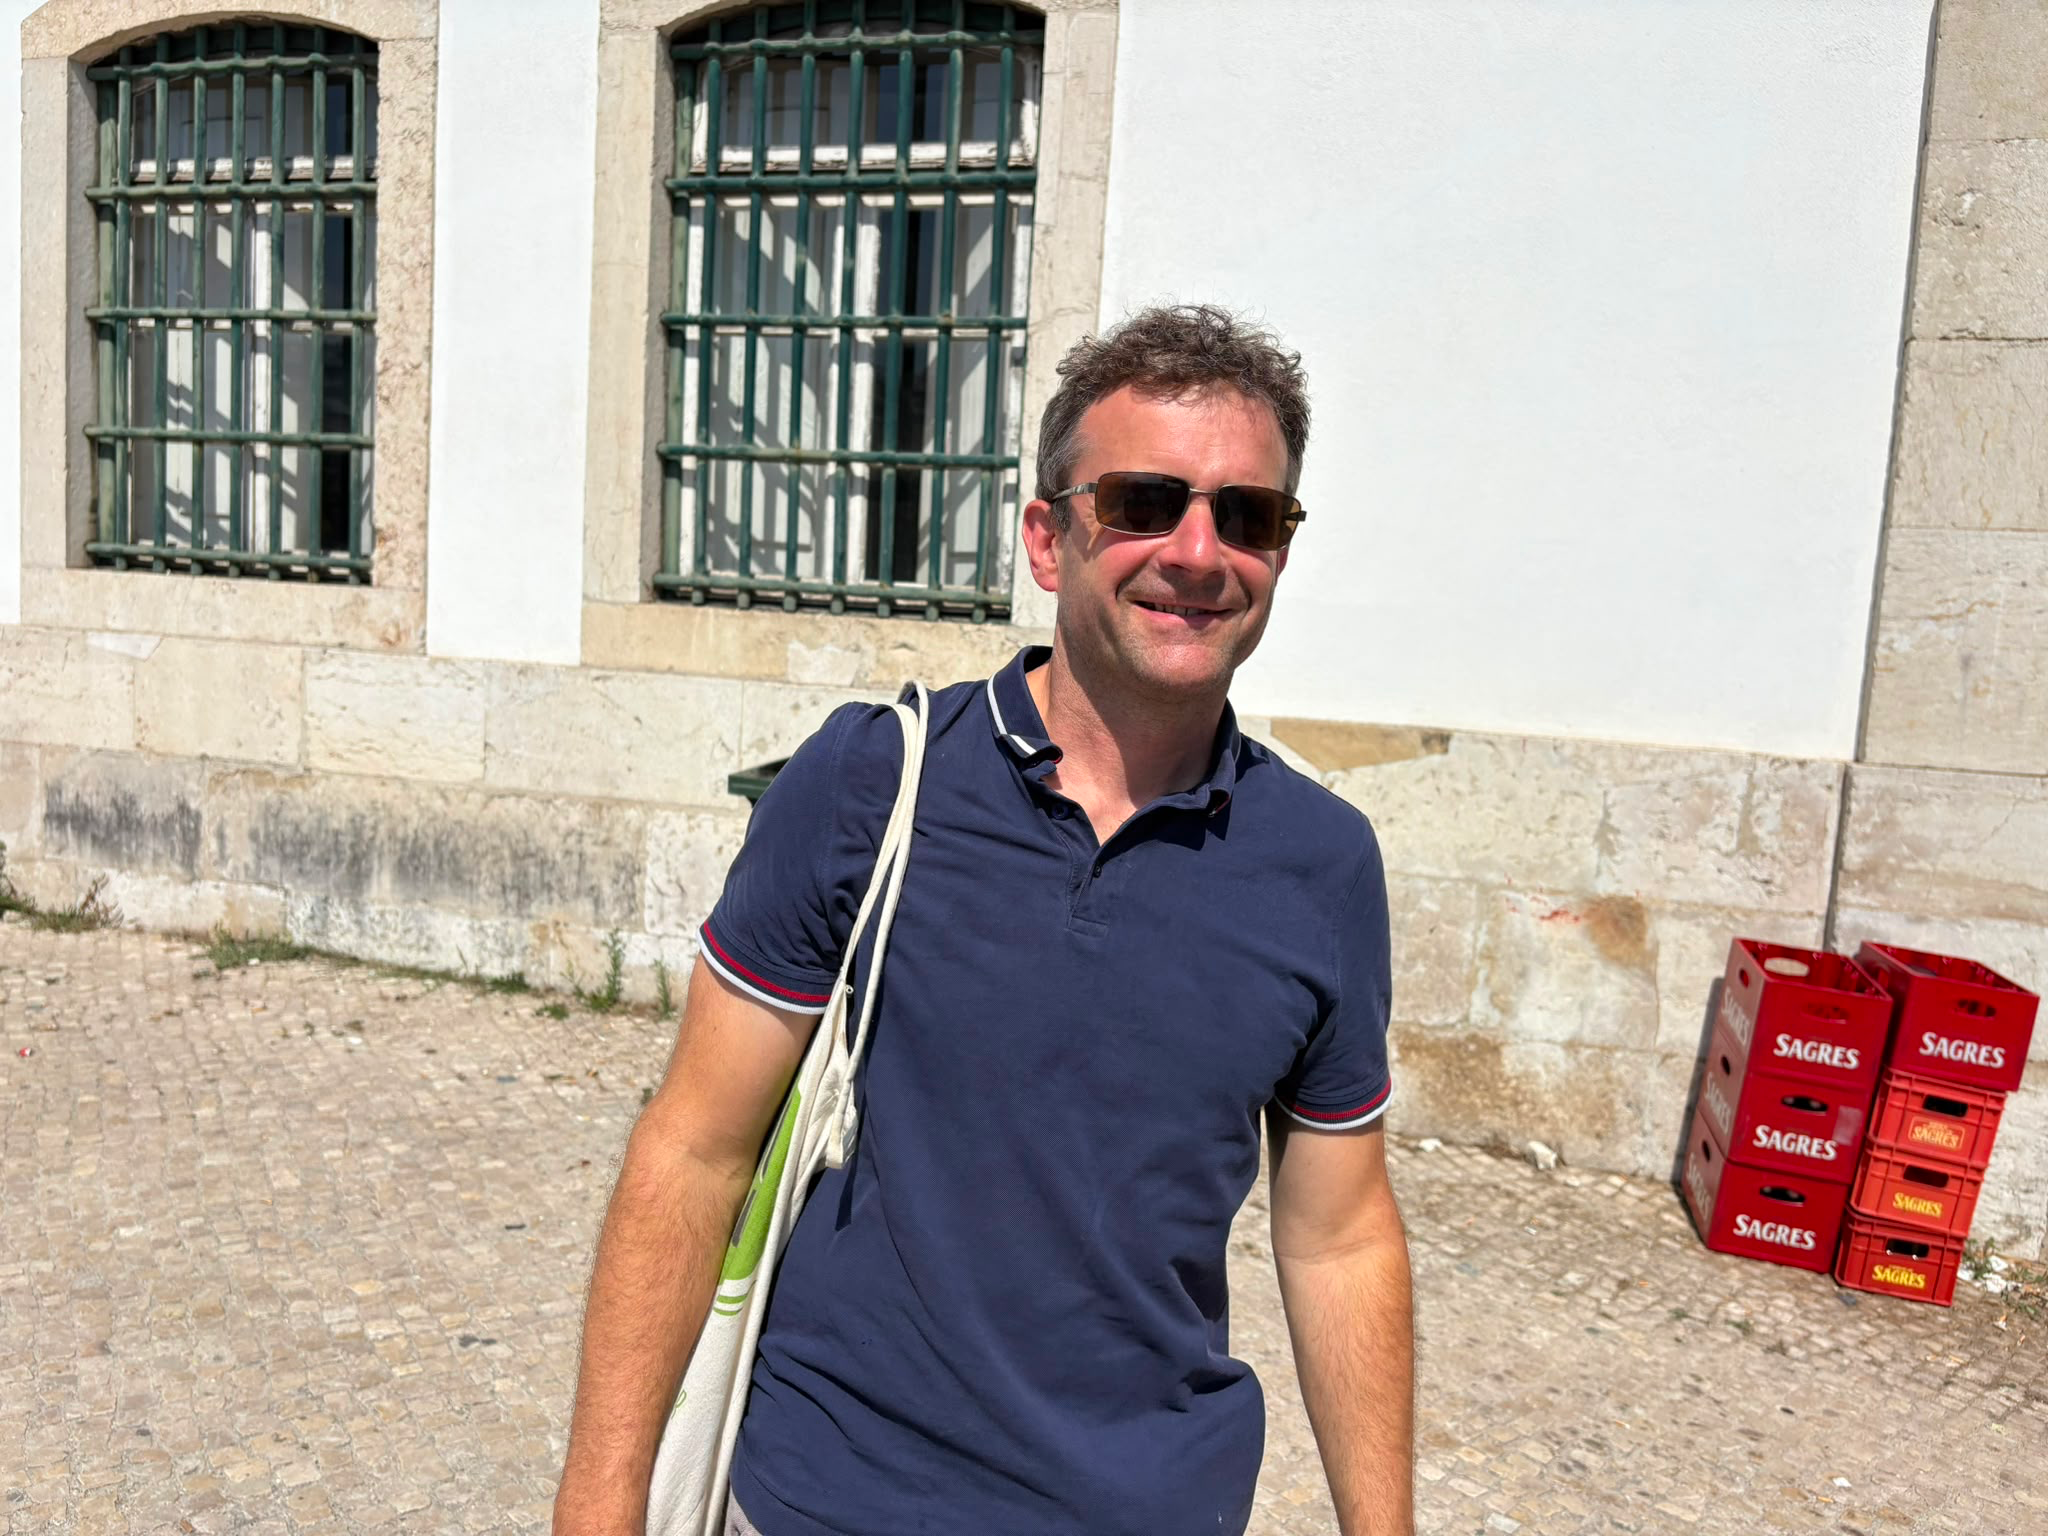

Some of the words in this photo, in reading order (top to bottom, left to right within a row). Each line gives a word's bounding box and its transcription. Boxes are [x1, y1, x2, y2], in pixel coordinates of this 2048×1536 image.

[1773, 1033, 1860, 1070] SAGRES
[1919, 1031, 2006, 1069] SAGRES
[1753, 1124, 1838, 1161] SAGRES
[1893, 1192, 1943, 1218] SAGRES
[1733, 1213, 1816, 1251] SAGRES
[1872, 1264, 1926, 1289] SAGRES
